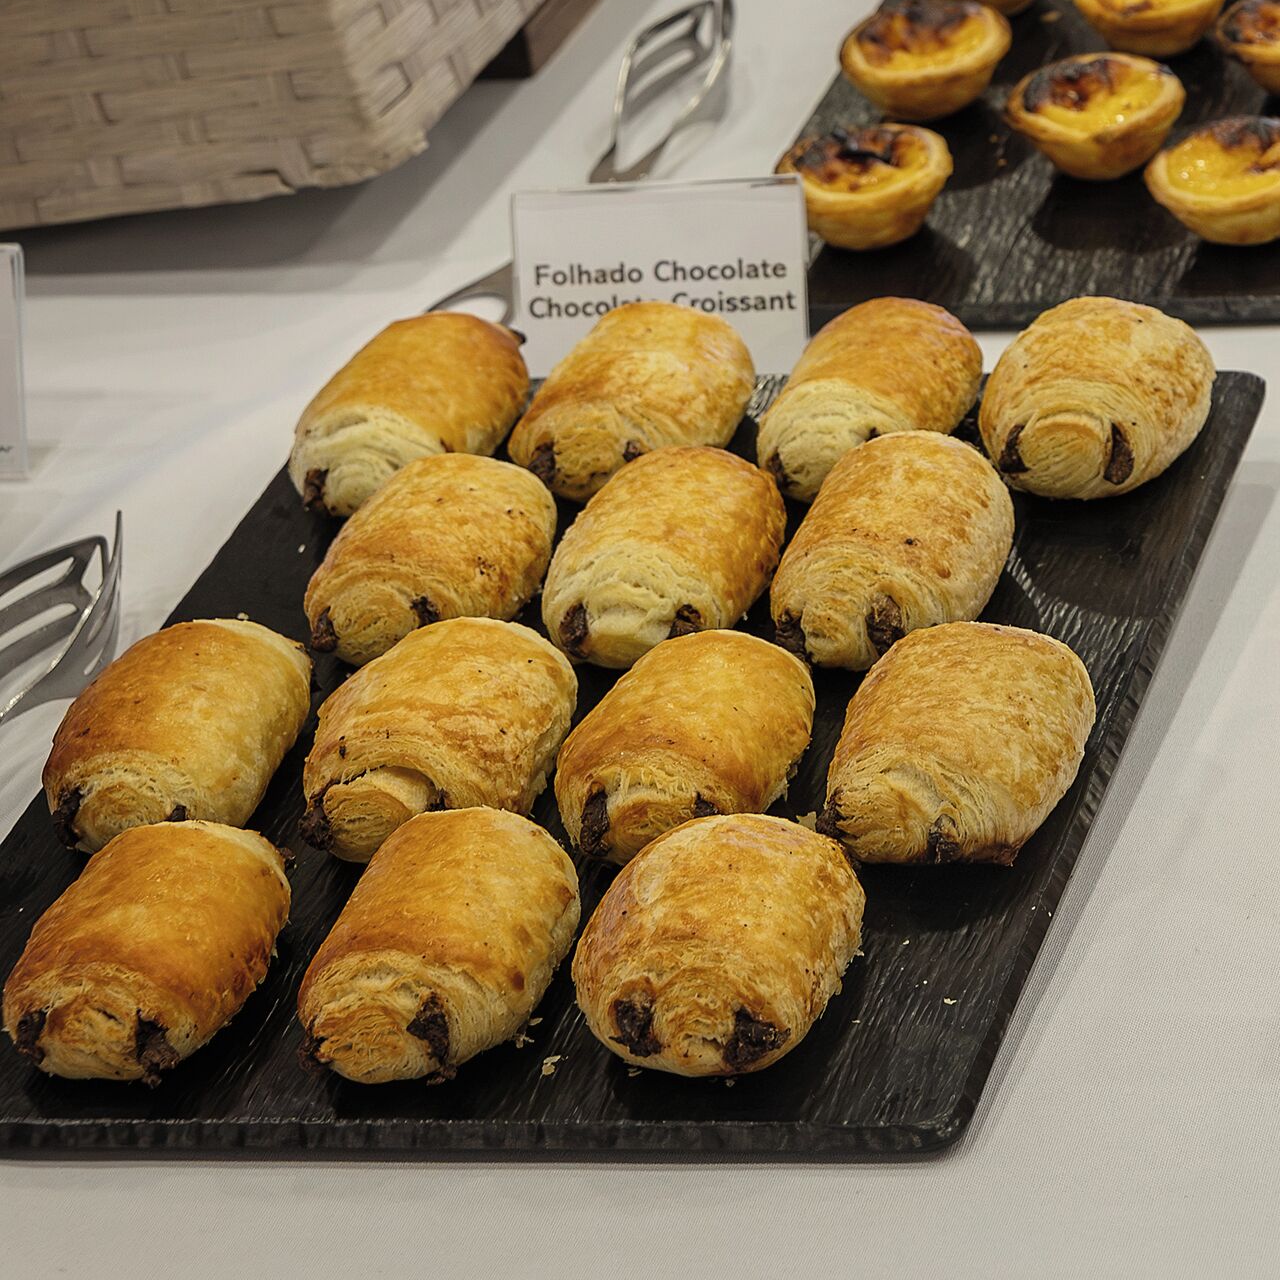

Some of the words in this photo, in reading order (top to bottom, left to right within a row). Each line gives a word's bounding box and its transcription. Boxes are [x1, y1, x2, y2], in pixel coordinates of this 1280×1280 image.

[534, 262, 643, 286] Folhado
[654, 258, 787, 282] Chocolate
[529, 294, 657, 318] Chocol
[672, 290, 797, 313] Croissant
